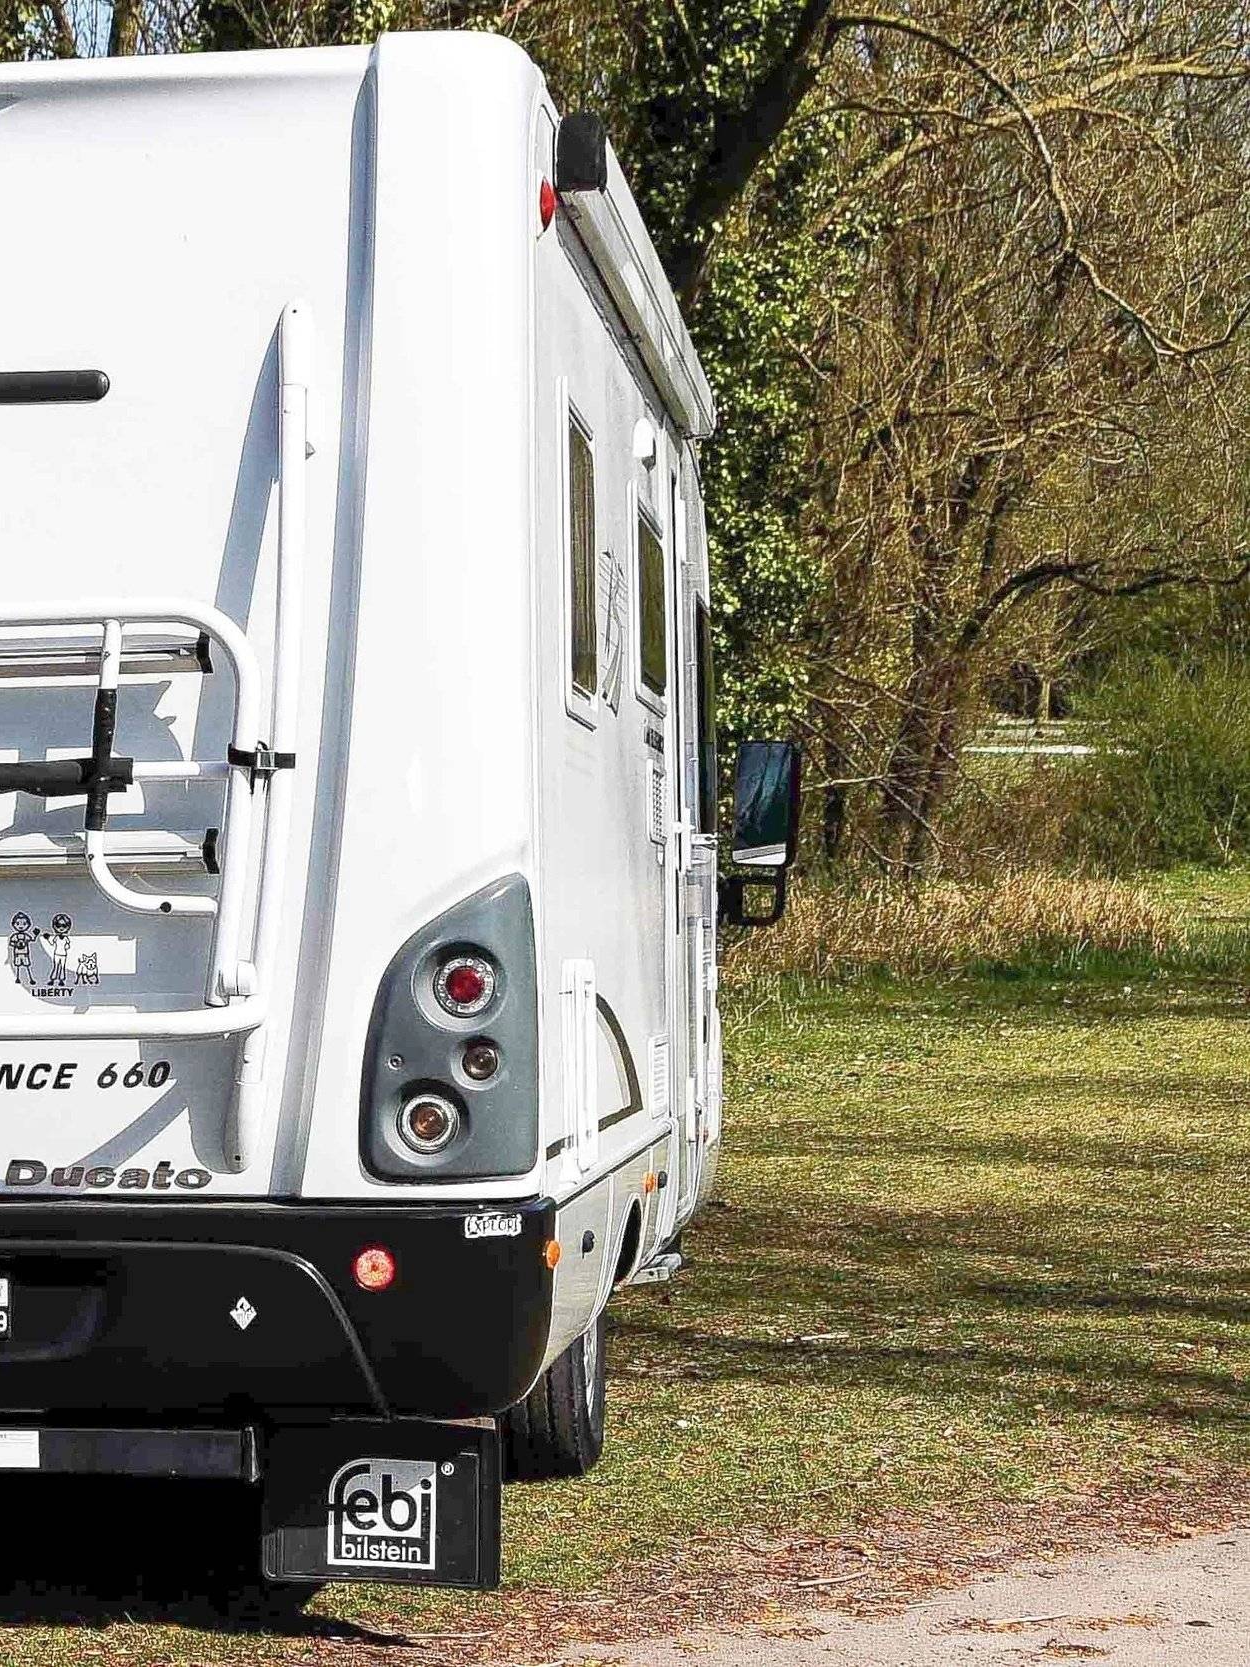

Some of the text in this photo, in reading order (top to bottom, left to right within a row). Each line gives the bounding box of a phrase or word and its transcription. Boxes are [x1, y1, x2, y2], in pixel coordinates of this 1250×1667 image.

[31, 987, 74, 997] LIBERTY
[97, 1061, 171, 1089] 660
[5, 1160, 213, 1190] Ducato
[327, 1463, 432, 1537] febi
[341, 1535, 421, 1562] bilstein
